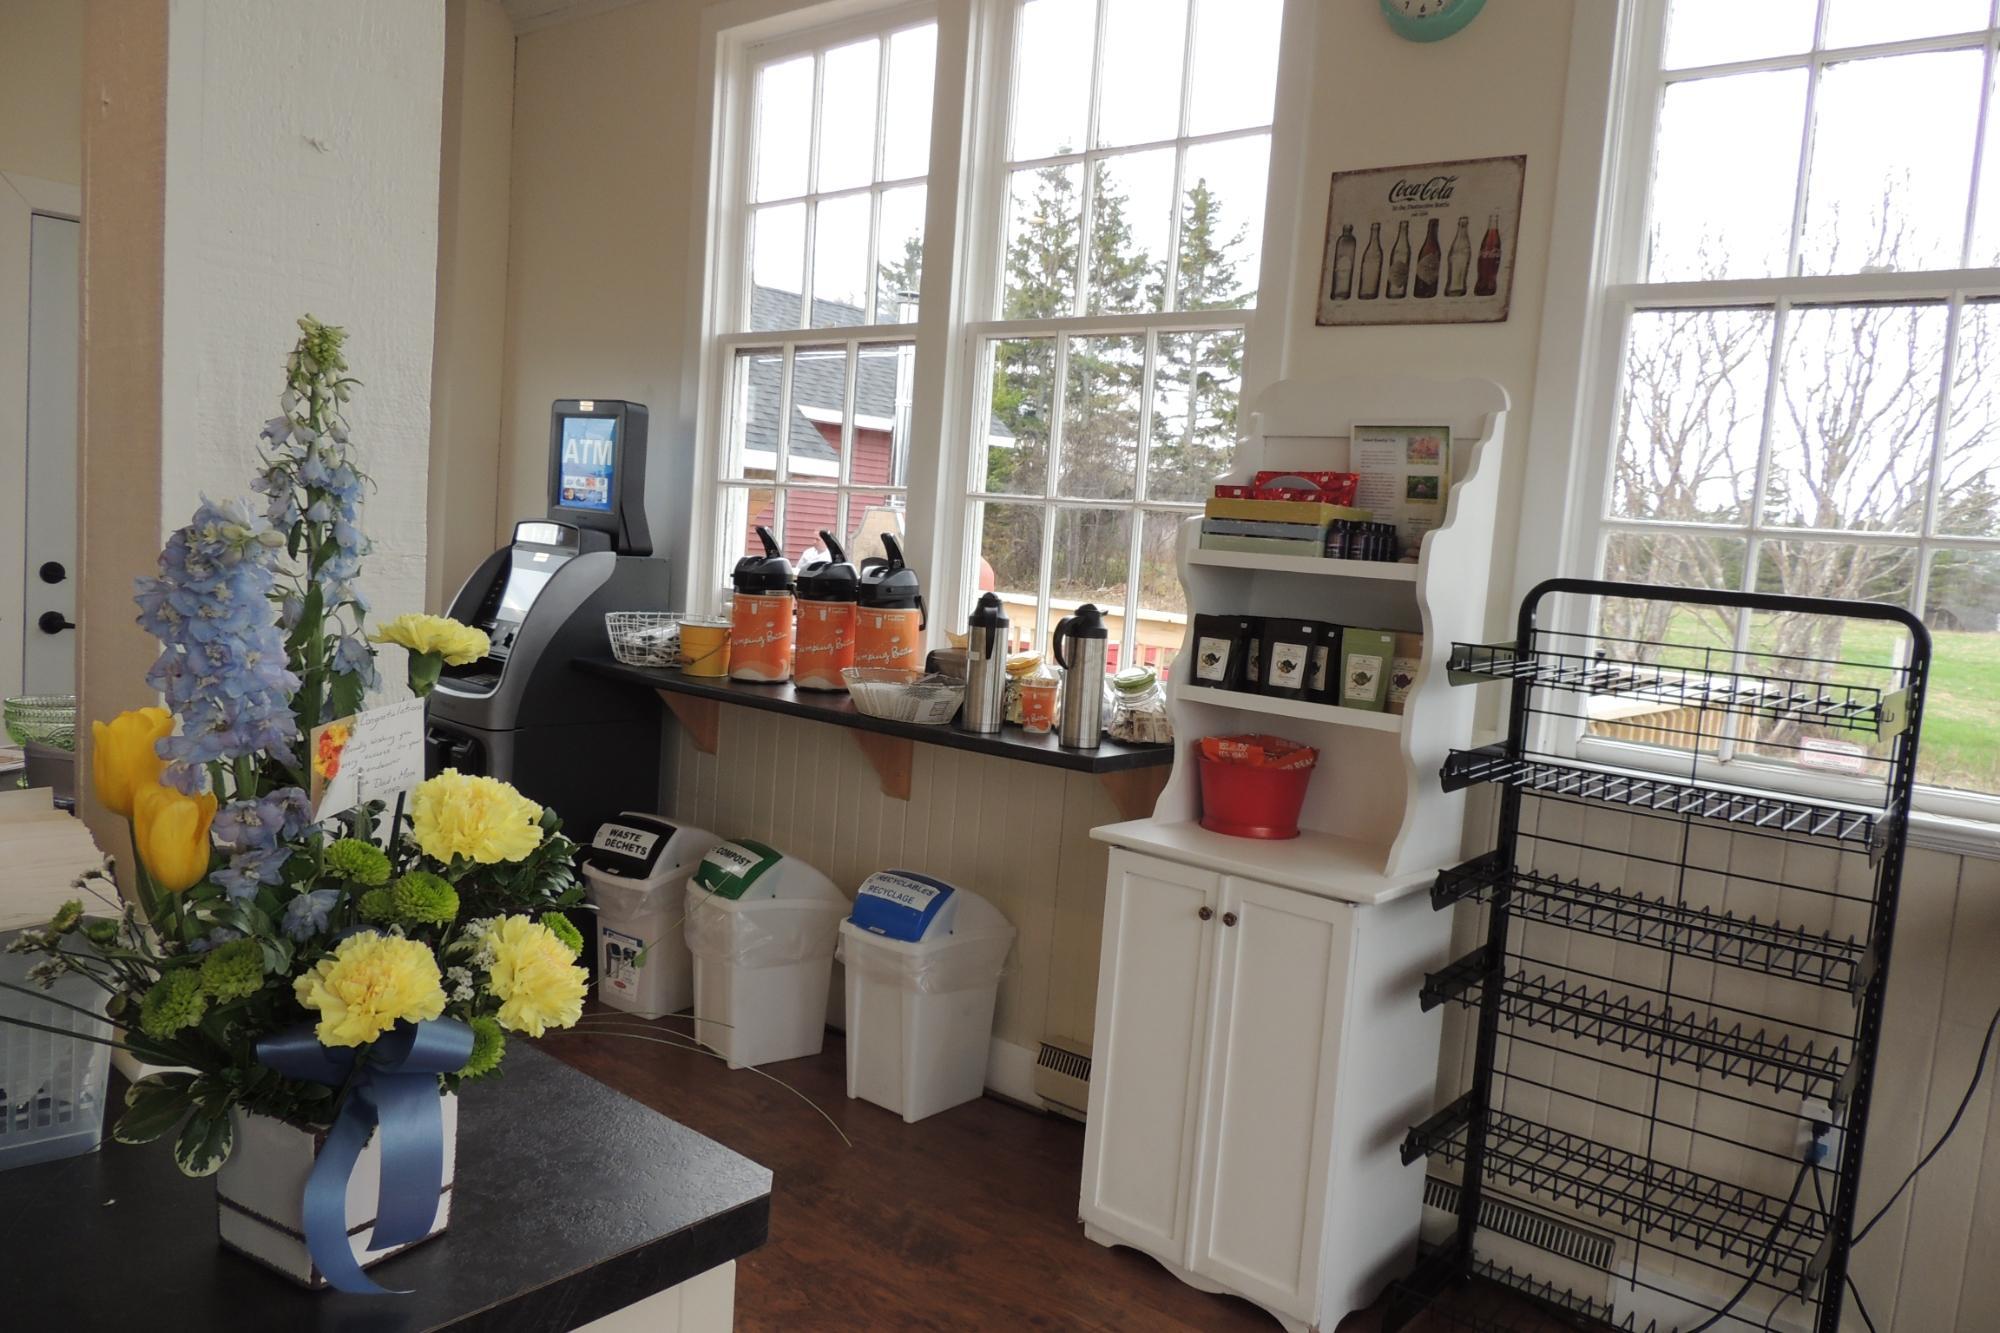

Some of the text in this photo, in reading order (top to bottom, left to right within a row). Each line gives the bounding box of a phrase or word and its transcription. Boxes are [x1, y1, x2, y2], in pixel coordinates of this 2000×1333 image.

[563, 438, 613, 465] ATM
[609, 829, 643, 842] WASTE
[716, 847, 752, 867] COMPOST
[868, 884, 915, 905] RECYCLAGE
[877, 875, 935, 897] RECYCLABLES
